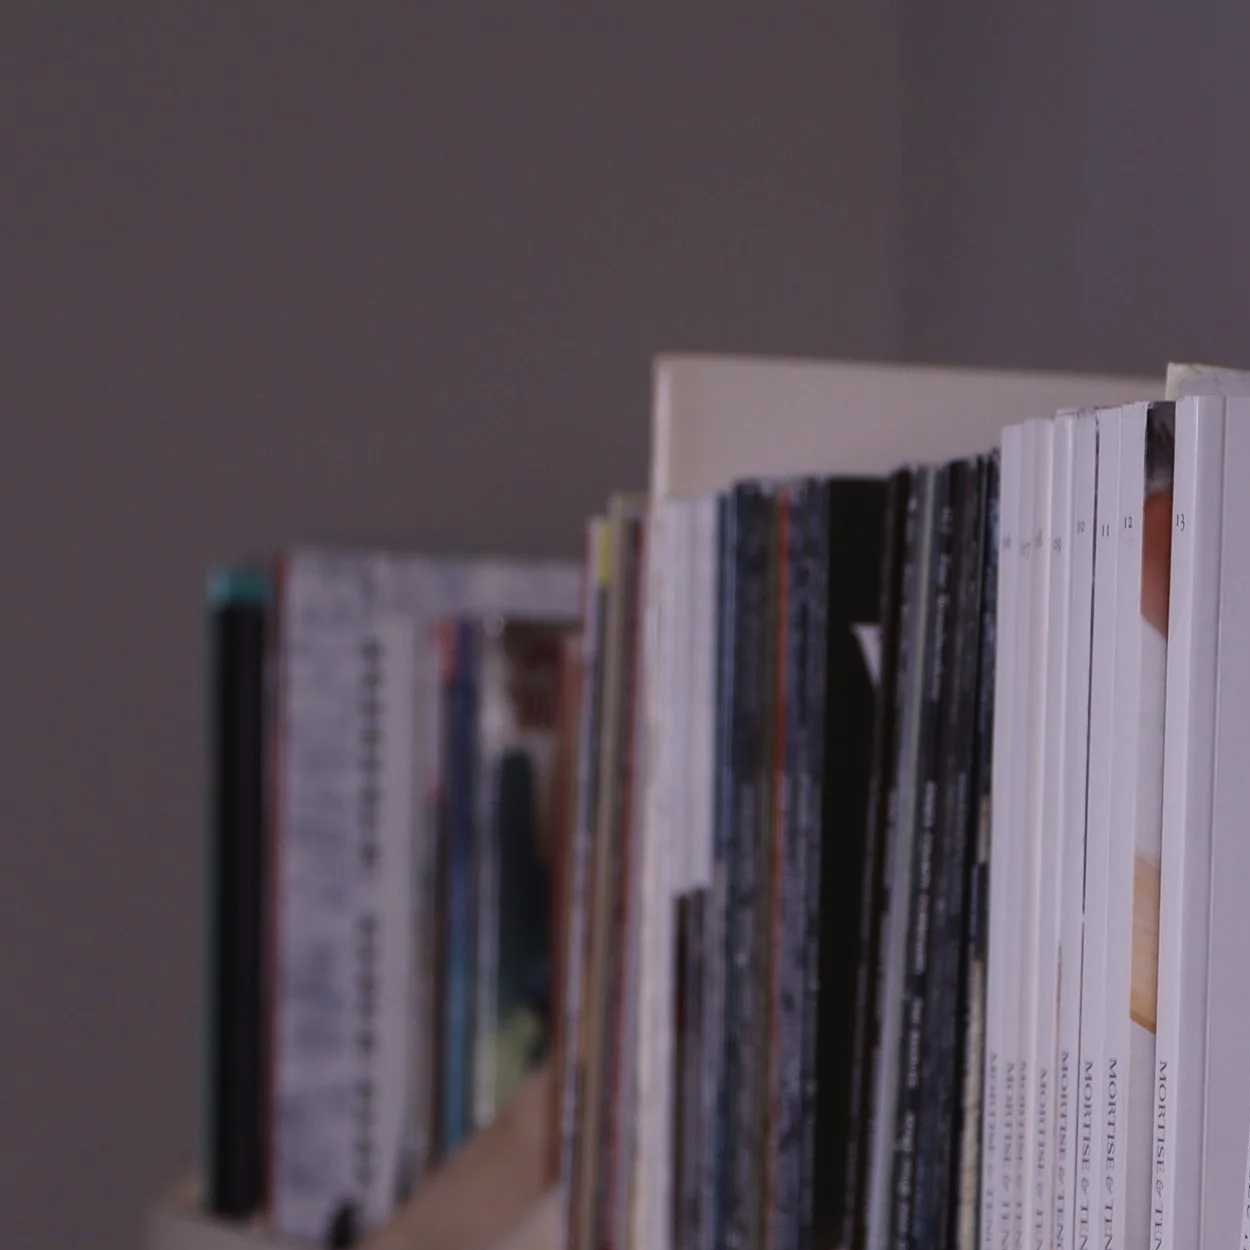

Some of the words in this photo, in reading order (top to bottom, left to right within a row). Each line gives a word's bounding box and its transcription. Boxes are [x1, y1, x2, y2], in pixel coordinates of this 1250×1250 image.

[1077, 520, 1086, 534] 10
[1101, 525, 1110, 537] 11
[1124, 516, 1133, 529] 12
[1176, 513, 1186, 531] 13
[1059, 1051, 1069, 1157] MORTISE
[1037, 1068, 1047, 1171] MORTISE
[1082, 1061, 1093, 1172] MORTISE
[1106, 1057, 1117, 1170] MORTISE
[1156, 1061, 1168, 1174] MORTISE
[1080, 1177, 1090, 1195] &
[1105, 1176, 1114, 1194] &
[1155, 1179, 1164, 1197] &
